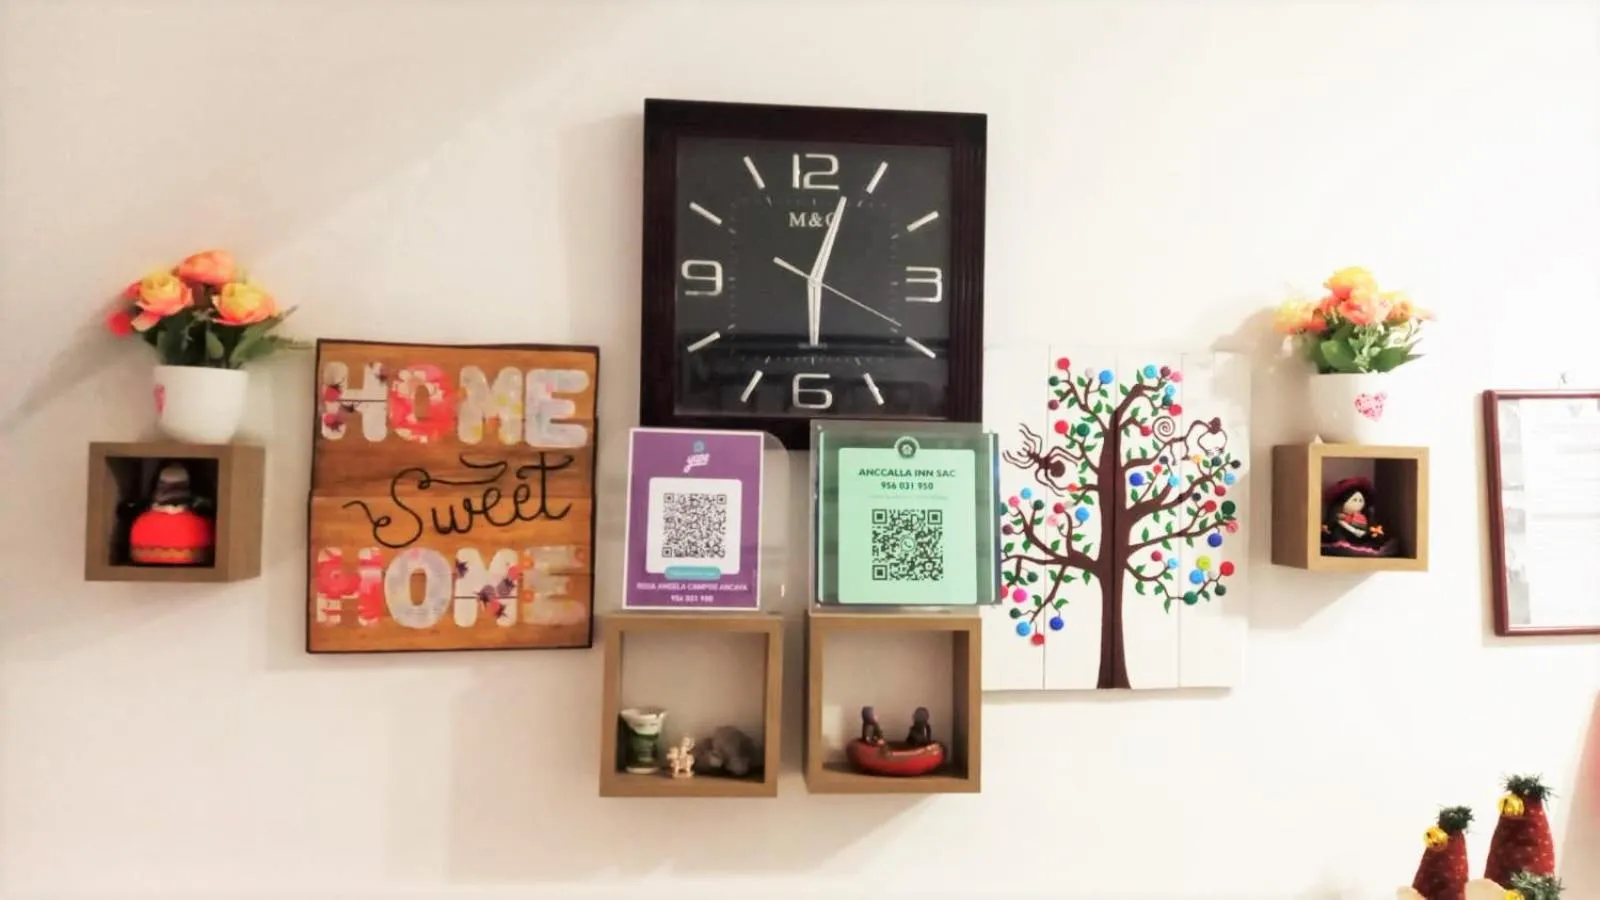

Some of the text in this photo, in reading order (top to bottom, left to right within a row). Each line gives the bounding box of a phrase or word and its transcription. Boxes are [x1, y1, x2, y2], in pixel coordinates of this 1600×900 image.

[792, 153, 839, 190] 12
[681, 259, 723, 296] 9
[905, 266, 942, 303] 3
[321, 361, 590, 448] HOME
[792, 373, 833, 410] 6
[859, 468, 956, 478] ANCCALLA INN SAC
[881, 481, 934, 491] 956 031 950
[342, 451, 574, 548] Sweet
[316, 545, 587, 629] HOME
